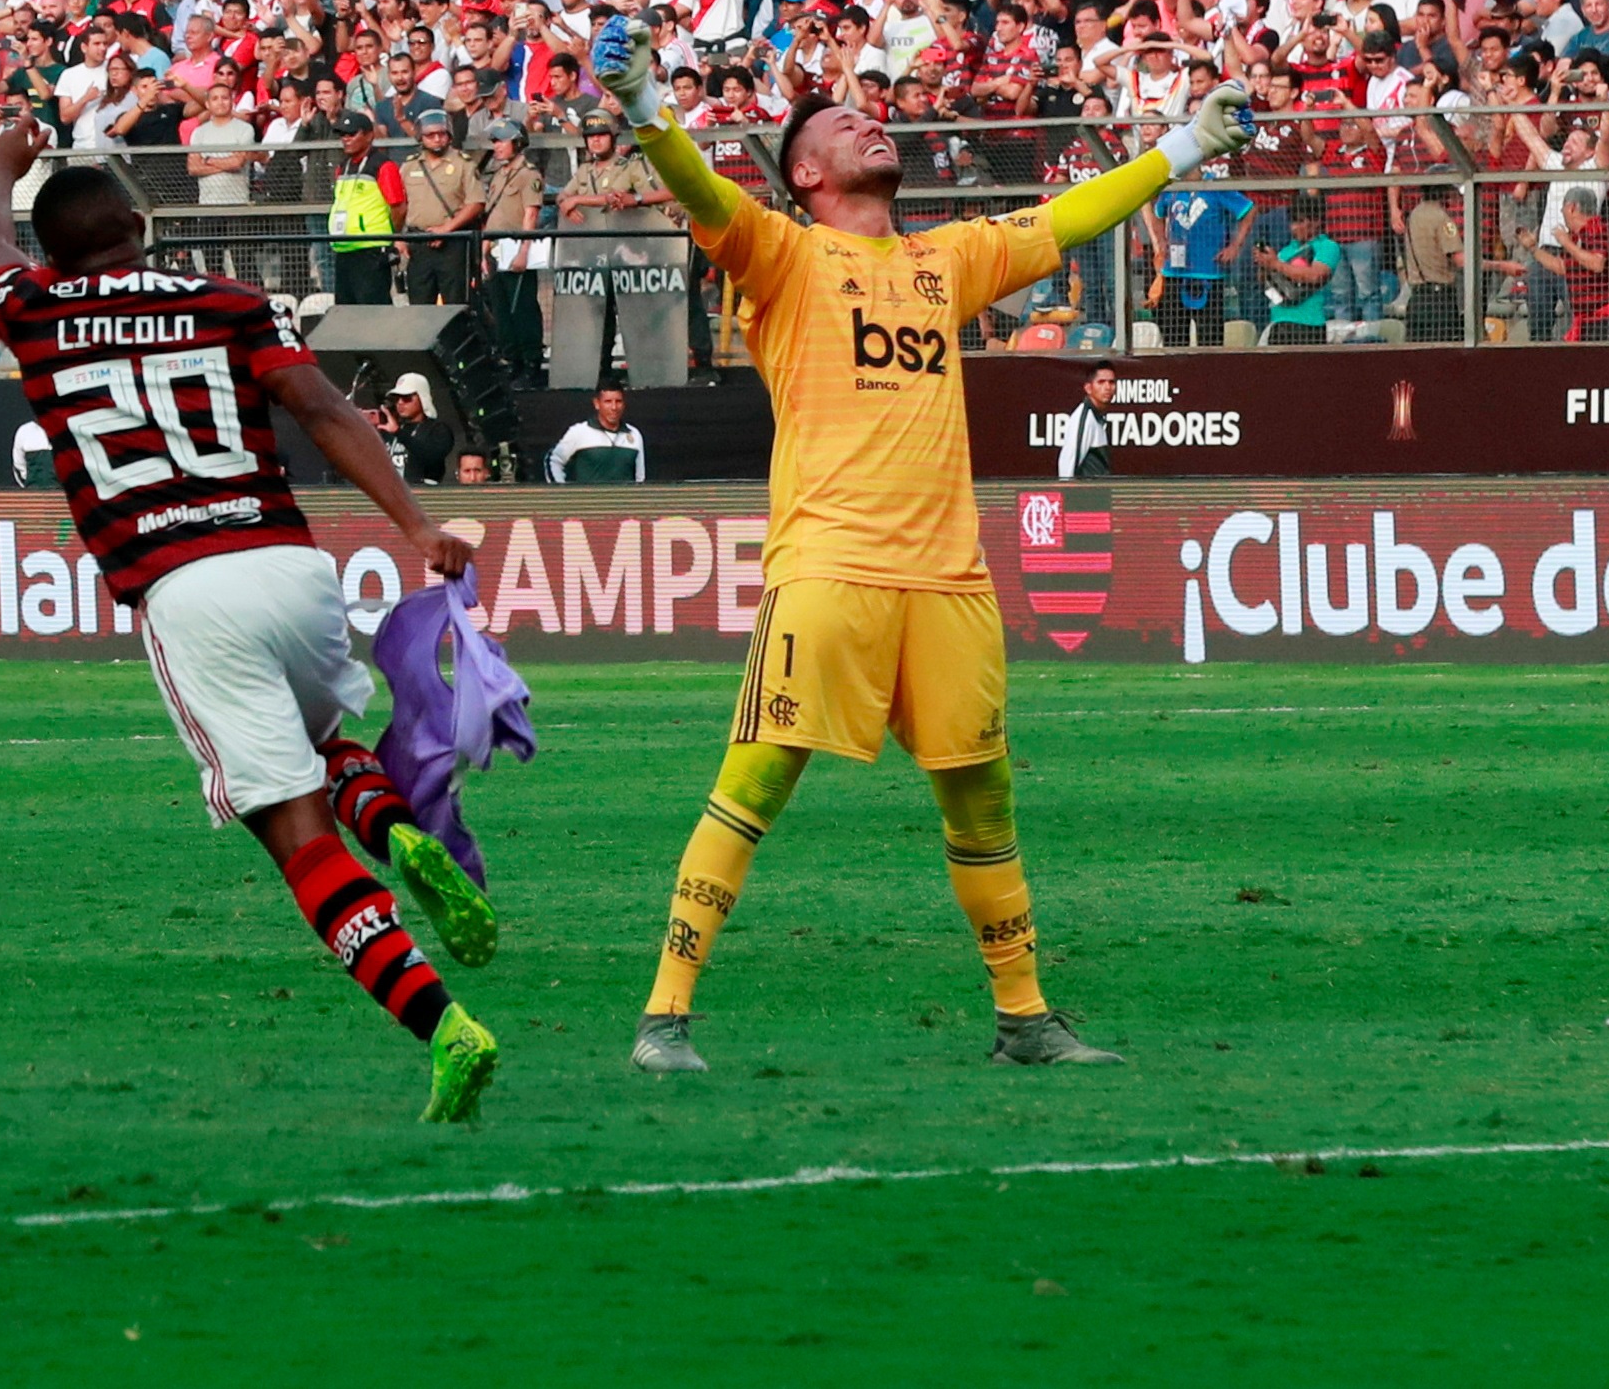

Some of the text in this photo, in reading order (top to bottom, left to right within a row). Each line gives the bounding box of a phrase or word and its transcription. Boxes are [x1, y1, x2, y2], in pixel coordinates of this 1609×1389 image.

[714, 140, 742, 156] bs2
[99, 271, 207, 296] MRV
[57, 315, 194, 351] LINCOLN
[852, 307, 947, 377] bs2
[855, 378, 900, 391] Banco
[52, 346, 259, 500] 20
[1029, 411, 1240, 447] LIBTADORES
[1179, 509, 1505, 663] ¡Clube
[782, 633, 795, 679] 1
[333, 904, 380, 958] ZEITE
[342, 917, 391, 967] OYAL
